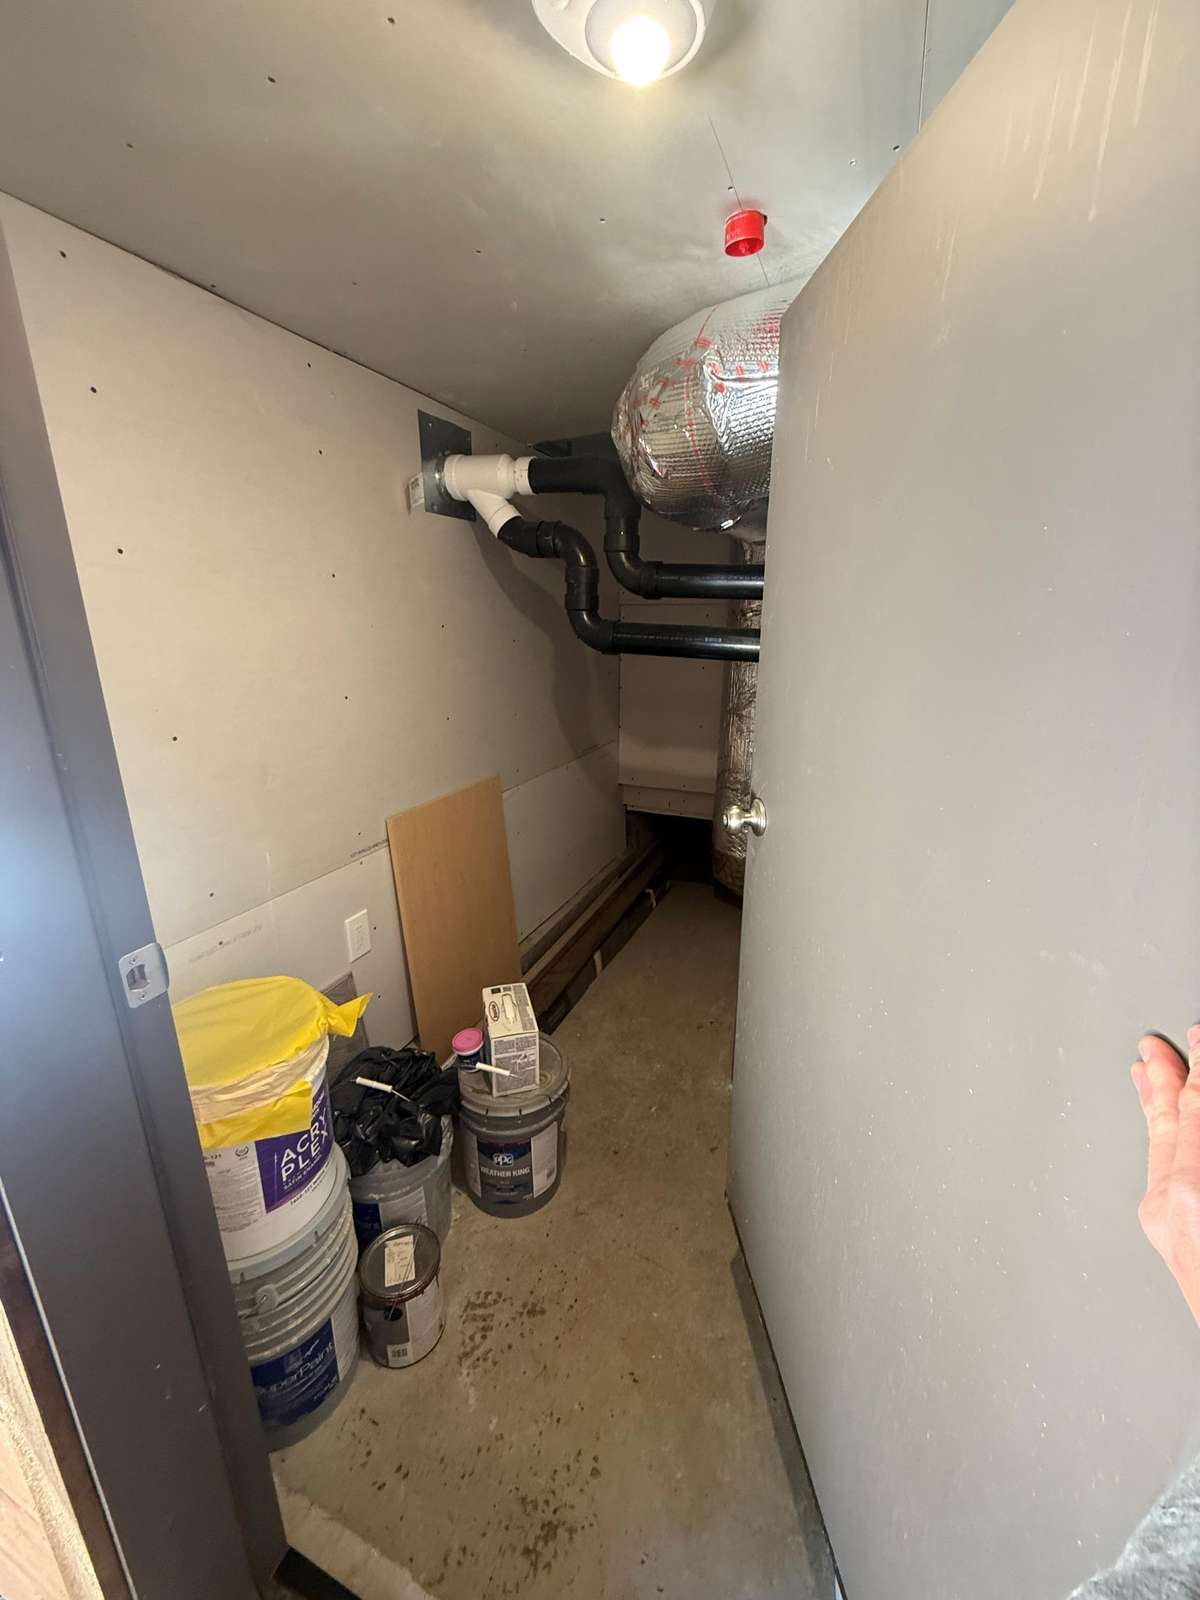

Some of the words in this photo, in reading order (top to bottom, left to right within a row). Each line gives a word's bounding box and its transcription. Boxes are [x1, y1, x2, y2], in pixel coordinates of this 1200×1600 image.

[281, 1107, 326, 1168] ACRY
[281, 1127, 328, 1183] PLEX
[494, 1154, 513, 1166] PPG
[513, 1167, 531, 1177] KING
